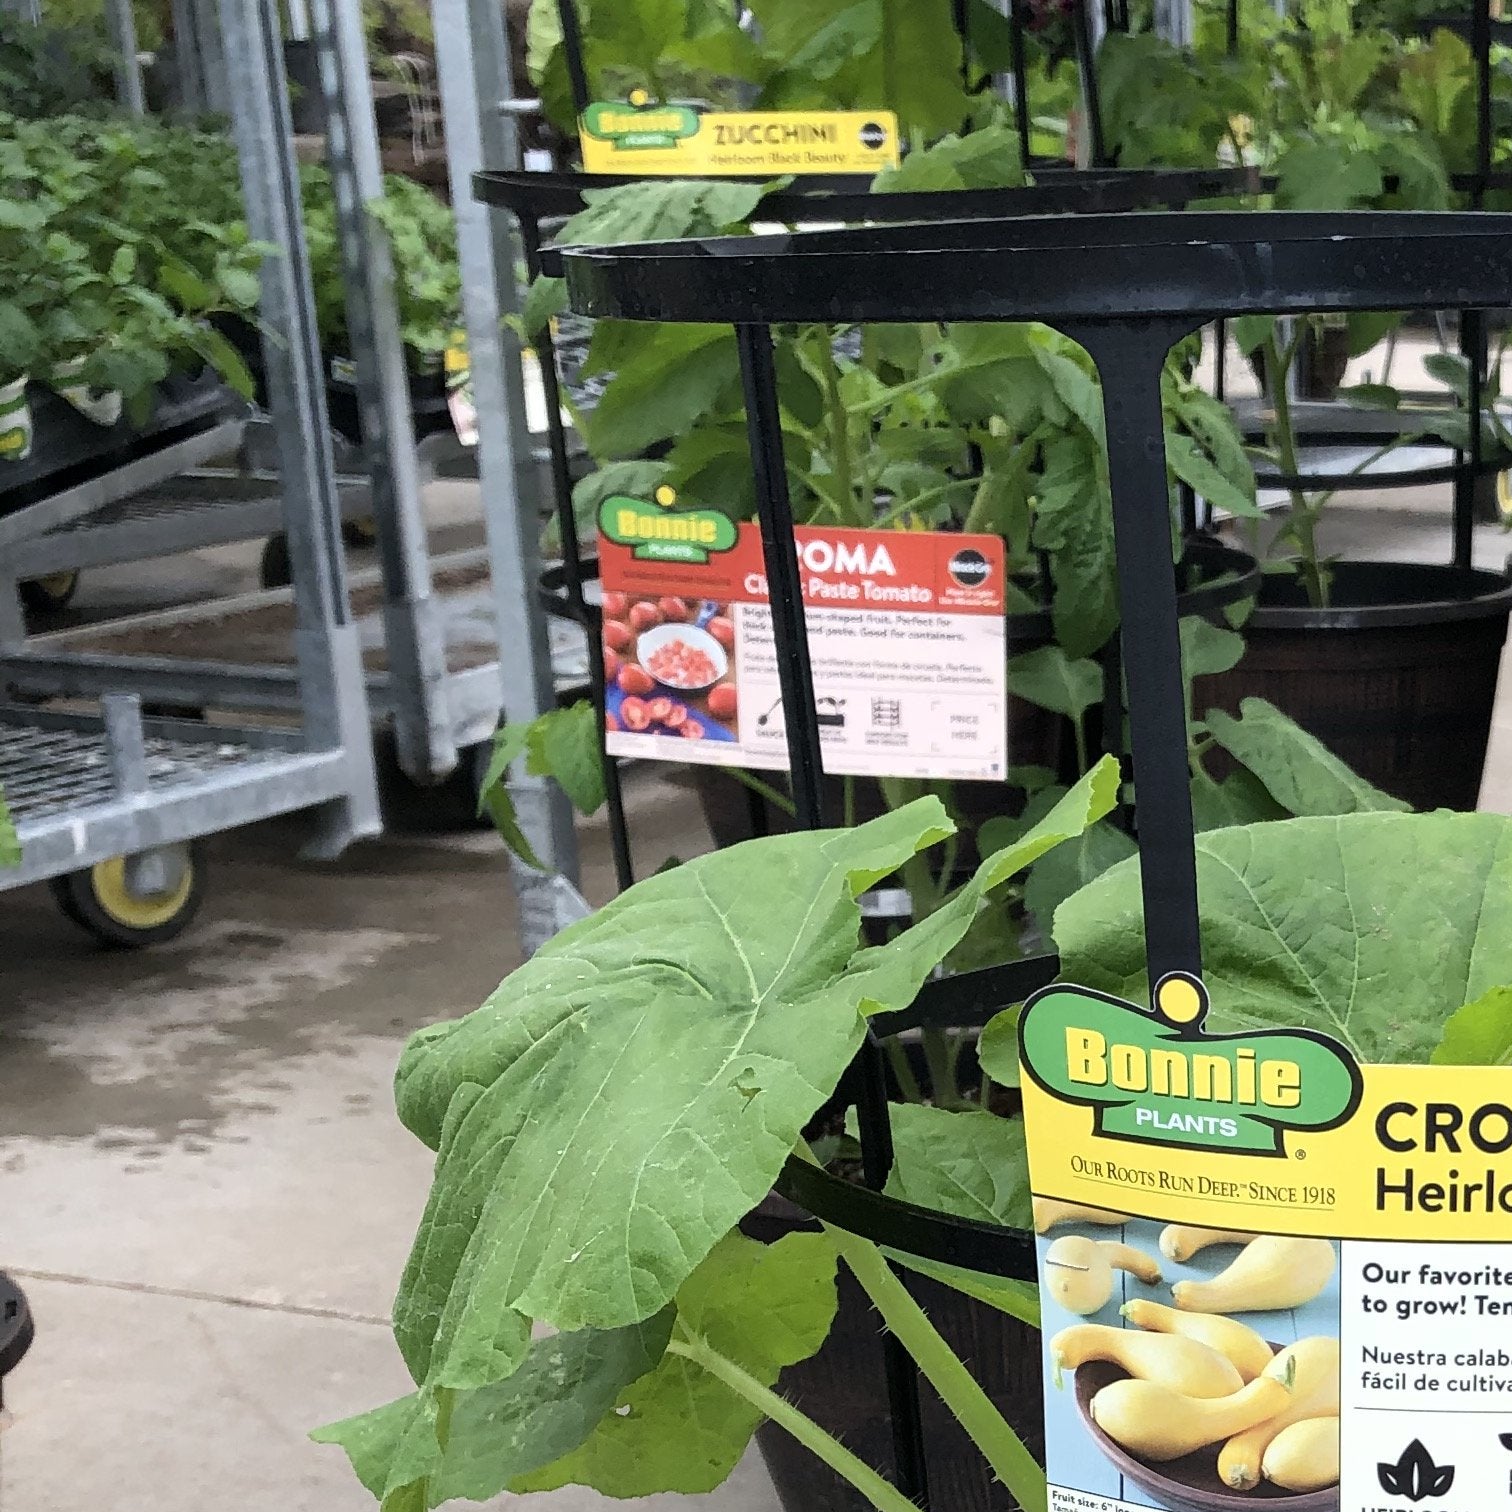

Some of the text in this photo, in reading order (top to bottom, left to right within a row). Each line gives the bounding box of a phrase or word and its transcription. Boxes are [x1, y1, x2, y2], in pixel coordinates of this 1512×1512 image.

[714, 124, 839, 145] ZUCCHINI
[617, 509, 717, 542] Bonnie
[808, 577, 861, 600] Paste
[862, 580, 932, 602] Tomato
[1065, 1026, 1302, 1108] Bonnie
[1136, 1108, 1238, 1137] PLANTS
[1071, 1156, 1103, 1178] OUR
[1106, 1161, 1156, 1188] ROOTS
[1158, 1170, 1194, 1193] RUN
[1249, 1181, 1298, 1203] SINCE
[1302, 1187, 1336, 1205] 1918
[1362, 1262, 1411, 1284] Our
[1362, 1295, 1388, 1313] to
[1396, 1295, 1467, 1320] grow!
[1362, 1346, 1447, 1366] Nuestra
[1361, 1372, 1406, 1391] fácil
[1414, 1373, 1440, 1391] de
[1052, 1491, 1075, 1504] Fruit
